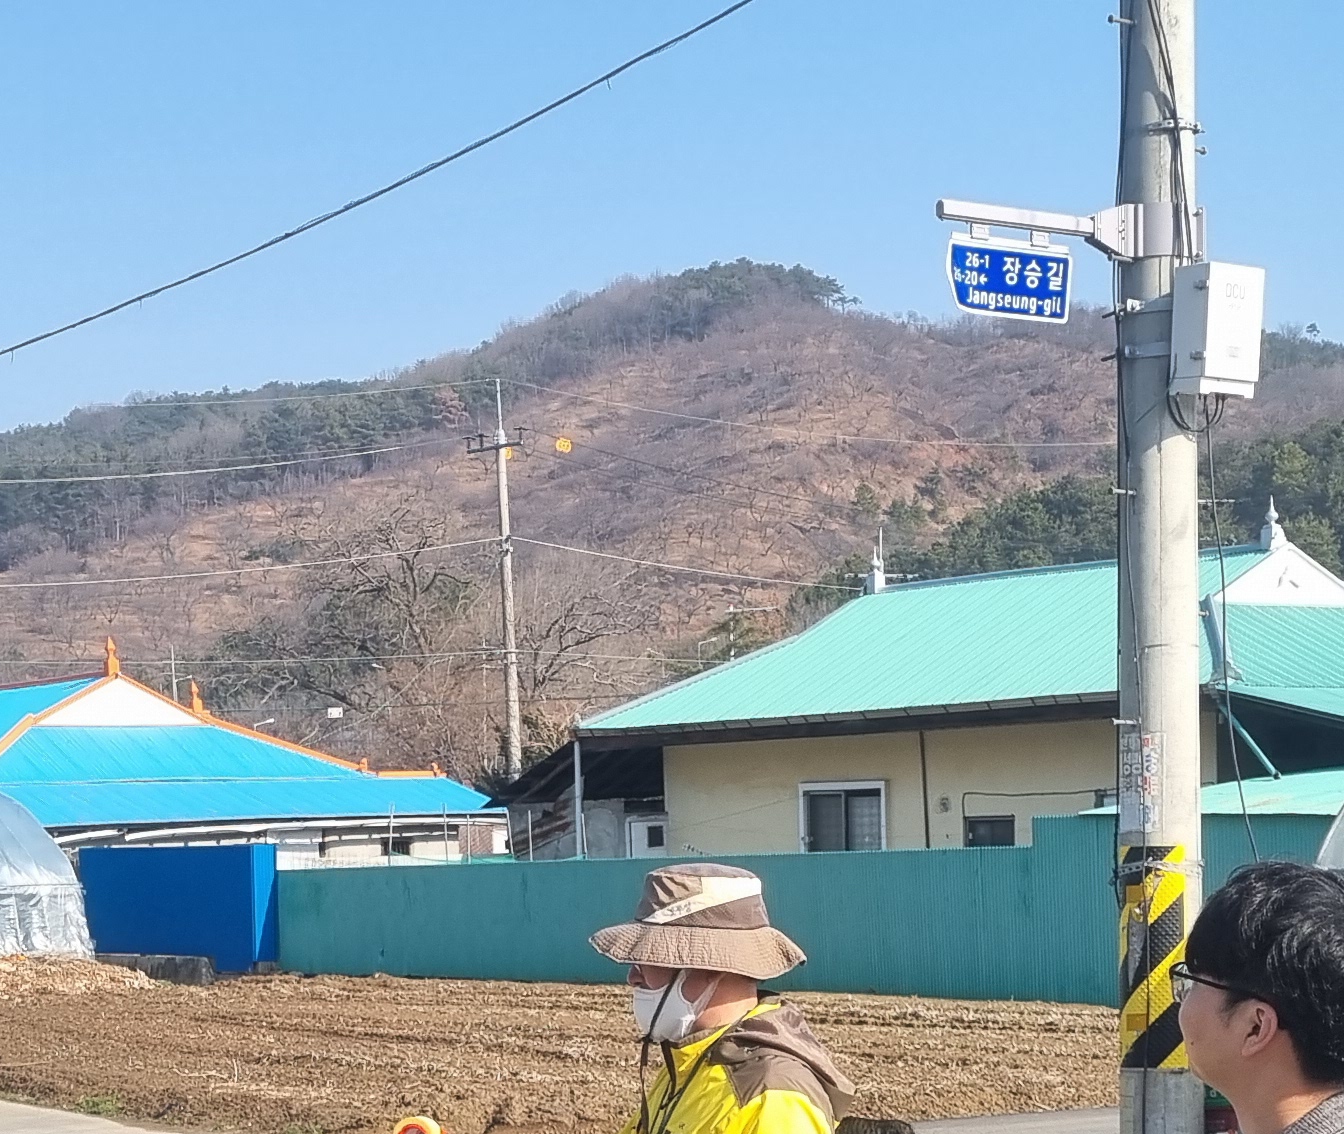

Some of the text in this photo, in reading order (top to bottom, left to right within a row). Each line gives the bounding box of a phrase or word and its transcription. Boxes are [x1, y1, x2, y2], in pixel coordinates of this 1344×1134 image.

[965, 252, 990, 269] 26-1
[1002, 256, 1064, 291] 장승길
[967, 286, 1061, 316] Jangseung-gil
[1225, 282, 1246, 300] DCU
